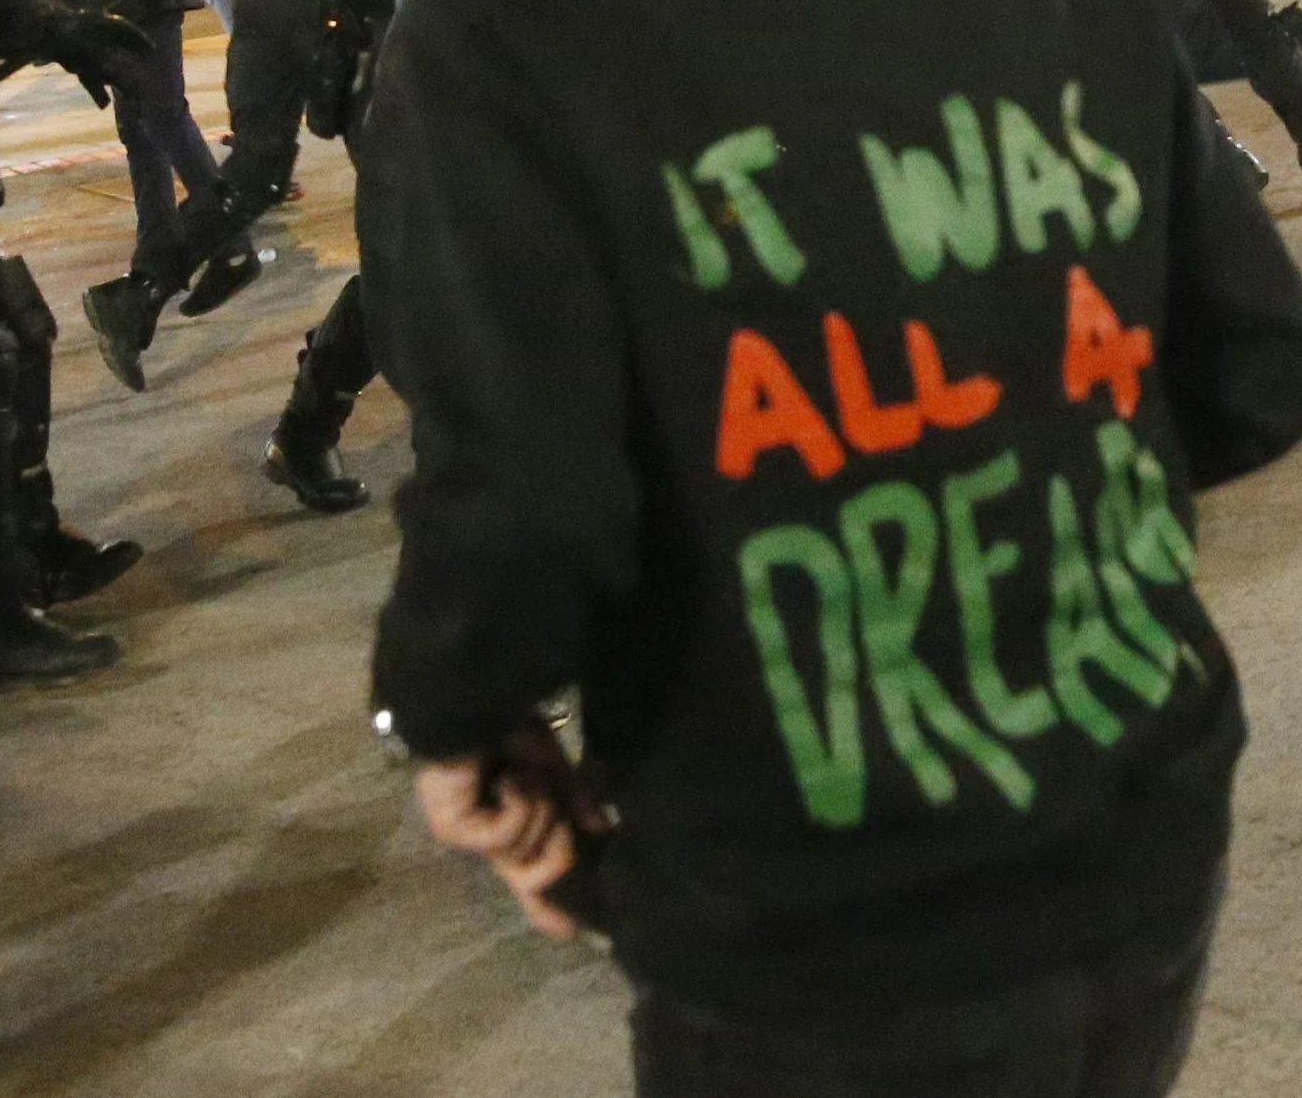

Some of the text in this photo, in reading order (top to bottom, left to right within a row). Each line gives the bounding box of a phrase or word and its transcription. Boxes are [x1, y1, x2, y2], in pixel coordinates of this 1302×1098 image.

[662, 80, 1142, 290] IT WAS
[715, 264, 1153, 480] ALL A
